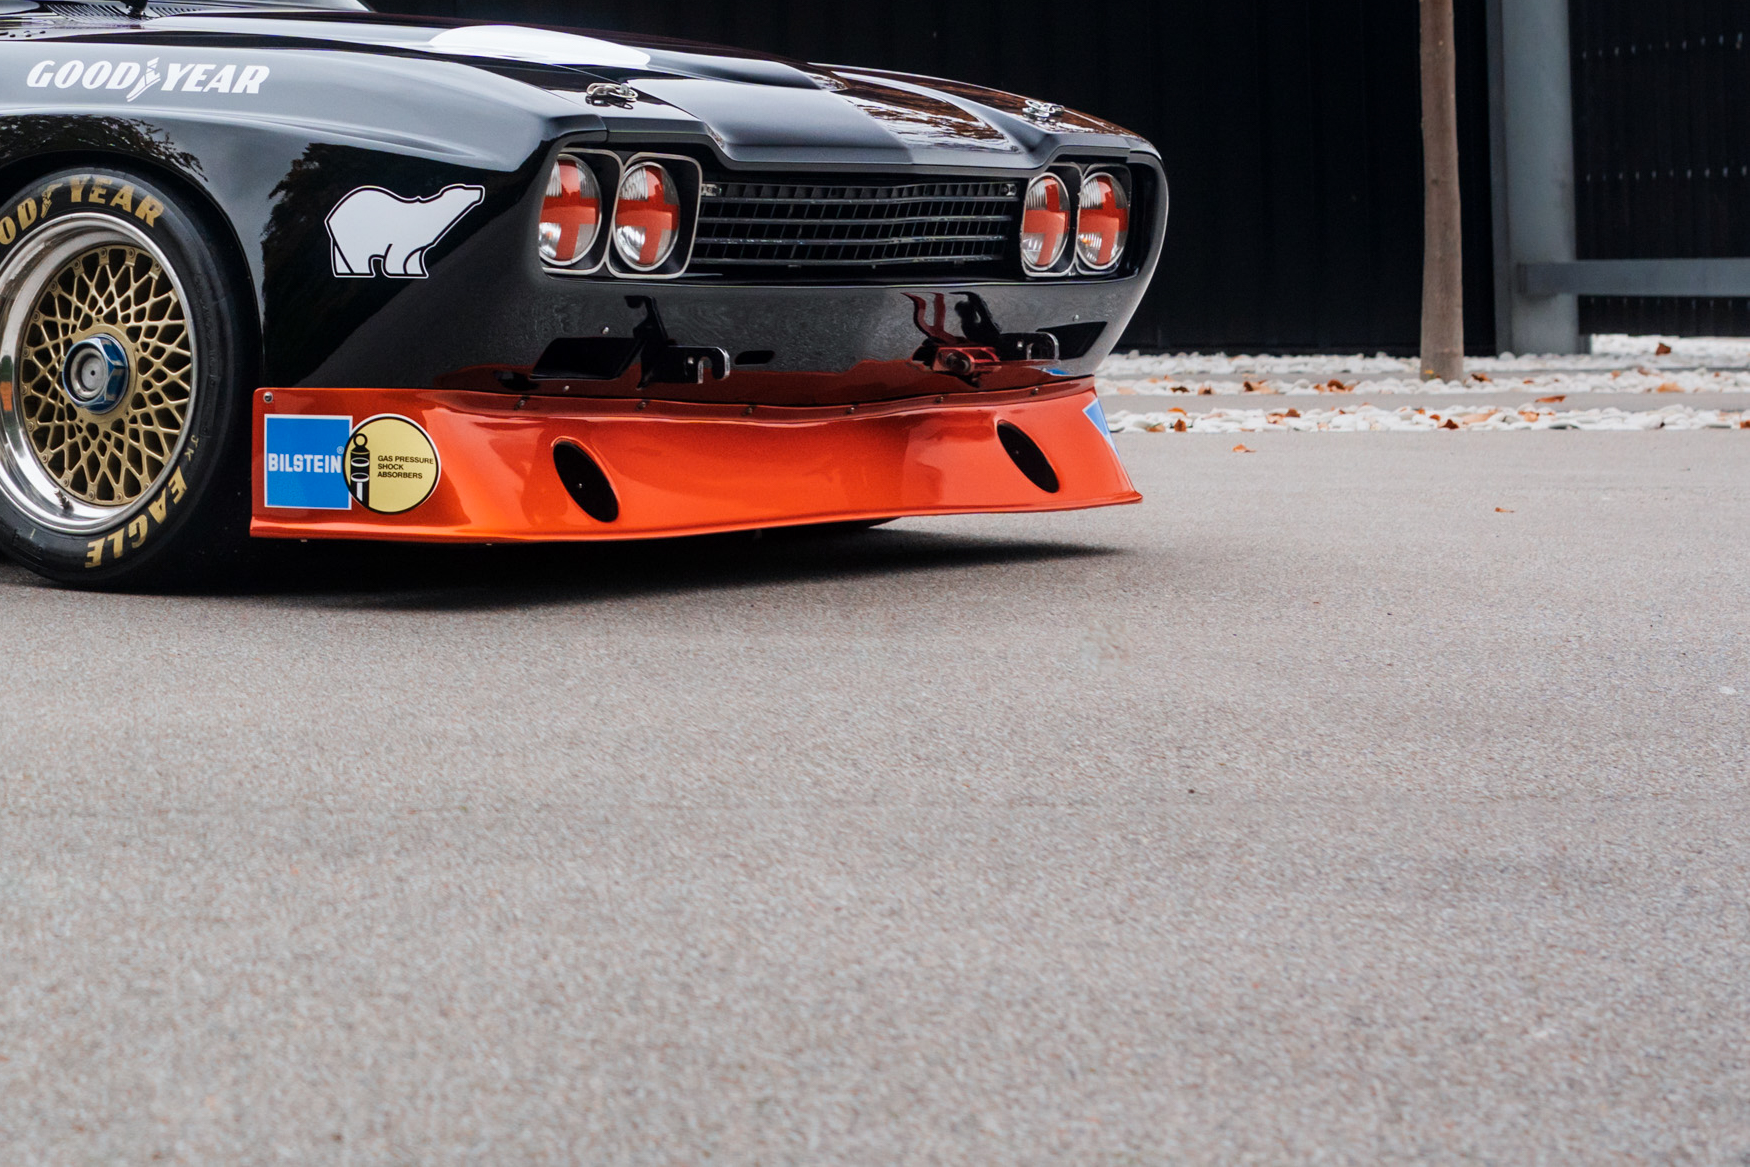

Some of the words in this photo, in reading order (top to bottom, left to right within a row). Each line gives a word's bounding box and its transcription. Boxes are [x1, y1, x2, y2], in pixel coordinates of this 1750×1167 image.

[267, 452, 342, 474] BILSTEIN
[394, 455, 434, 465] PRESSURE
[377, 471, 423, 479] ABSORBERS
[84, 465, 188, 569] EAGLE
